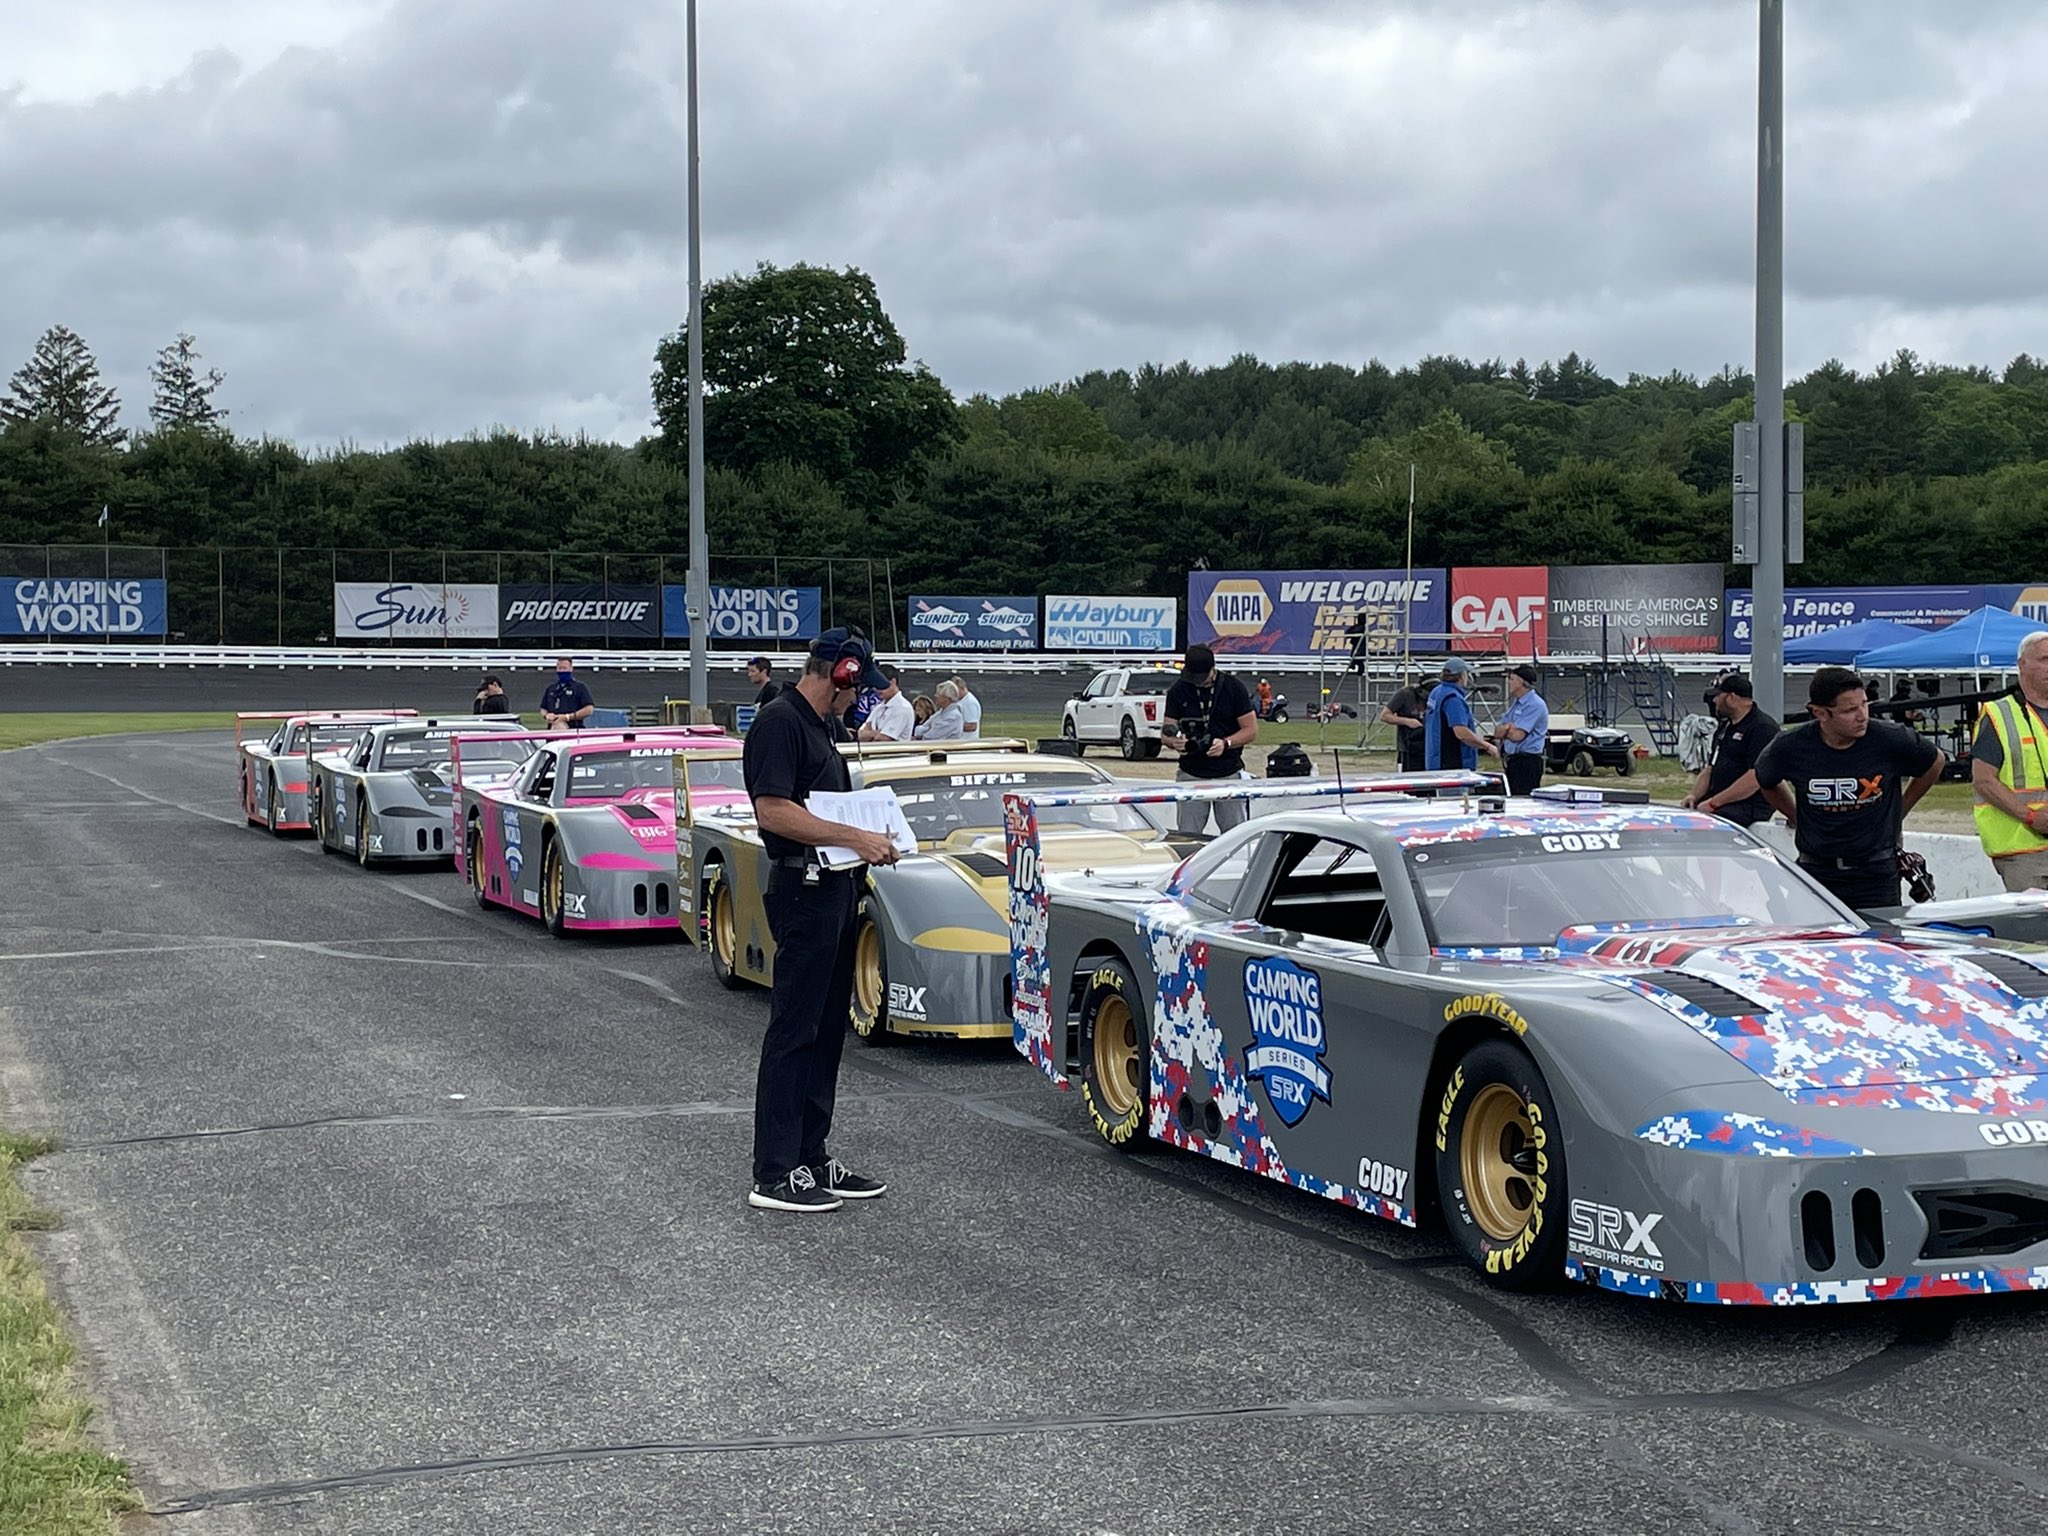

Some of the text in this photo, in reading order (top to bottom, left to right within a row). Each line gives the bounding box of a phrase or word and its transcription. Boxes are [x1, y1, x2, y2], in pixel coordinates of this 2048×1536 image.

[15, 580, 142, 605] CAMPING
[685, 588, 798, 611] AMPING
[1279, 580, 1432, 602] WELCOME
[15, 604, 142, 632] WORLD
[355, 585, 451, 630] Sun
[506, 600, 650, 621] PROGRESSIVE
[1049, 598, 1166, 627] Maybury
[1217, 595, 1262, 621] NAPA
[1452, 595, 1546, 633] GAF
[1552, 598, 1632, 613] TIMBERLINE
[1638, 597, 1719, 612] AMERICA'S
[1792, 598, 1855, 617] Fence
[915, 614, 1032, 624] SUNOCO SUNOCO
[1645, 612, 1709, 627] SHINGLE
[1733, 621, 1750, 639] &
[909, 639, 1037, 648] NEW ENGLAND RACING FUEL
[630, 747, 697, 758] KANA
[950, 772, 1027, 787] BIFFLE
[1806, 774, 1884, 801] SRX
[1540, 832, 1621, 854] COBY
[1014, 846, 1035, 891] 10
[1092, 968, 1124, 991] EAGLE
[1245, 963, 1320, 1010] CAMPING
[888, 982, 927, 1013] SRX
[1248, 995, 1322, 1047] WORLD
[1443, 991, 1529, 1036] GOODYEAR
[1268, 1050, 1306, 1072] SERIES
[1270, 1075, 1307, 1107] SRX
[1435, 1064, 1466, 1152] EAGLE
[1978, 1120, 2048, 1146] COB
[1358, 1156, 1410, 1201] COBY
[1485, 1102, 1549, 1274] GOODYEAR
[1567, 1197, 1665, 1258] SRX
[1568, 1241, 1665, 1273] SUPERSTAR RACING
